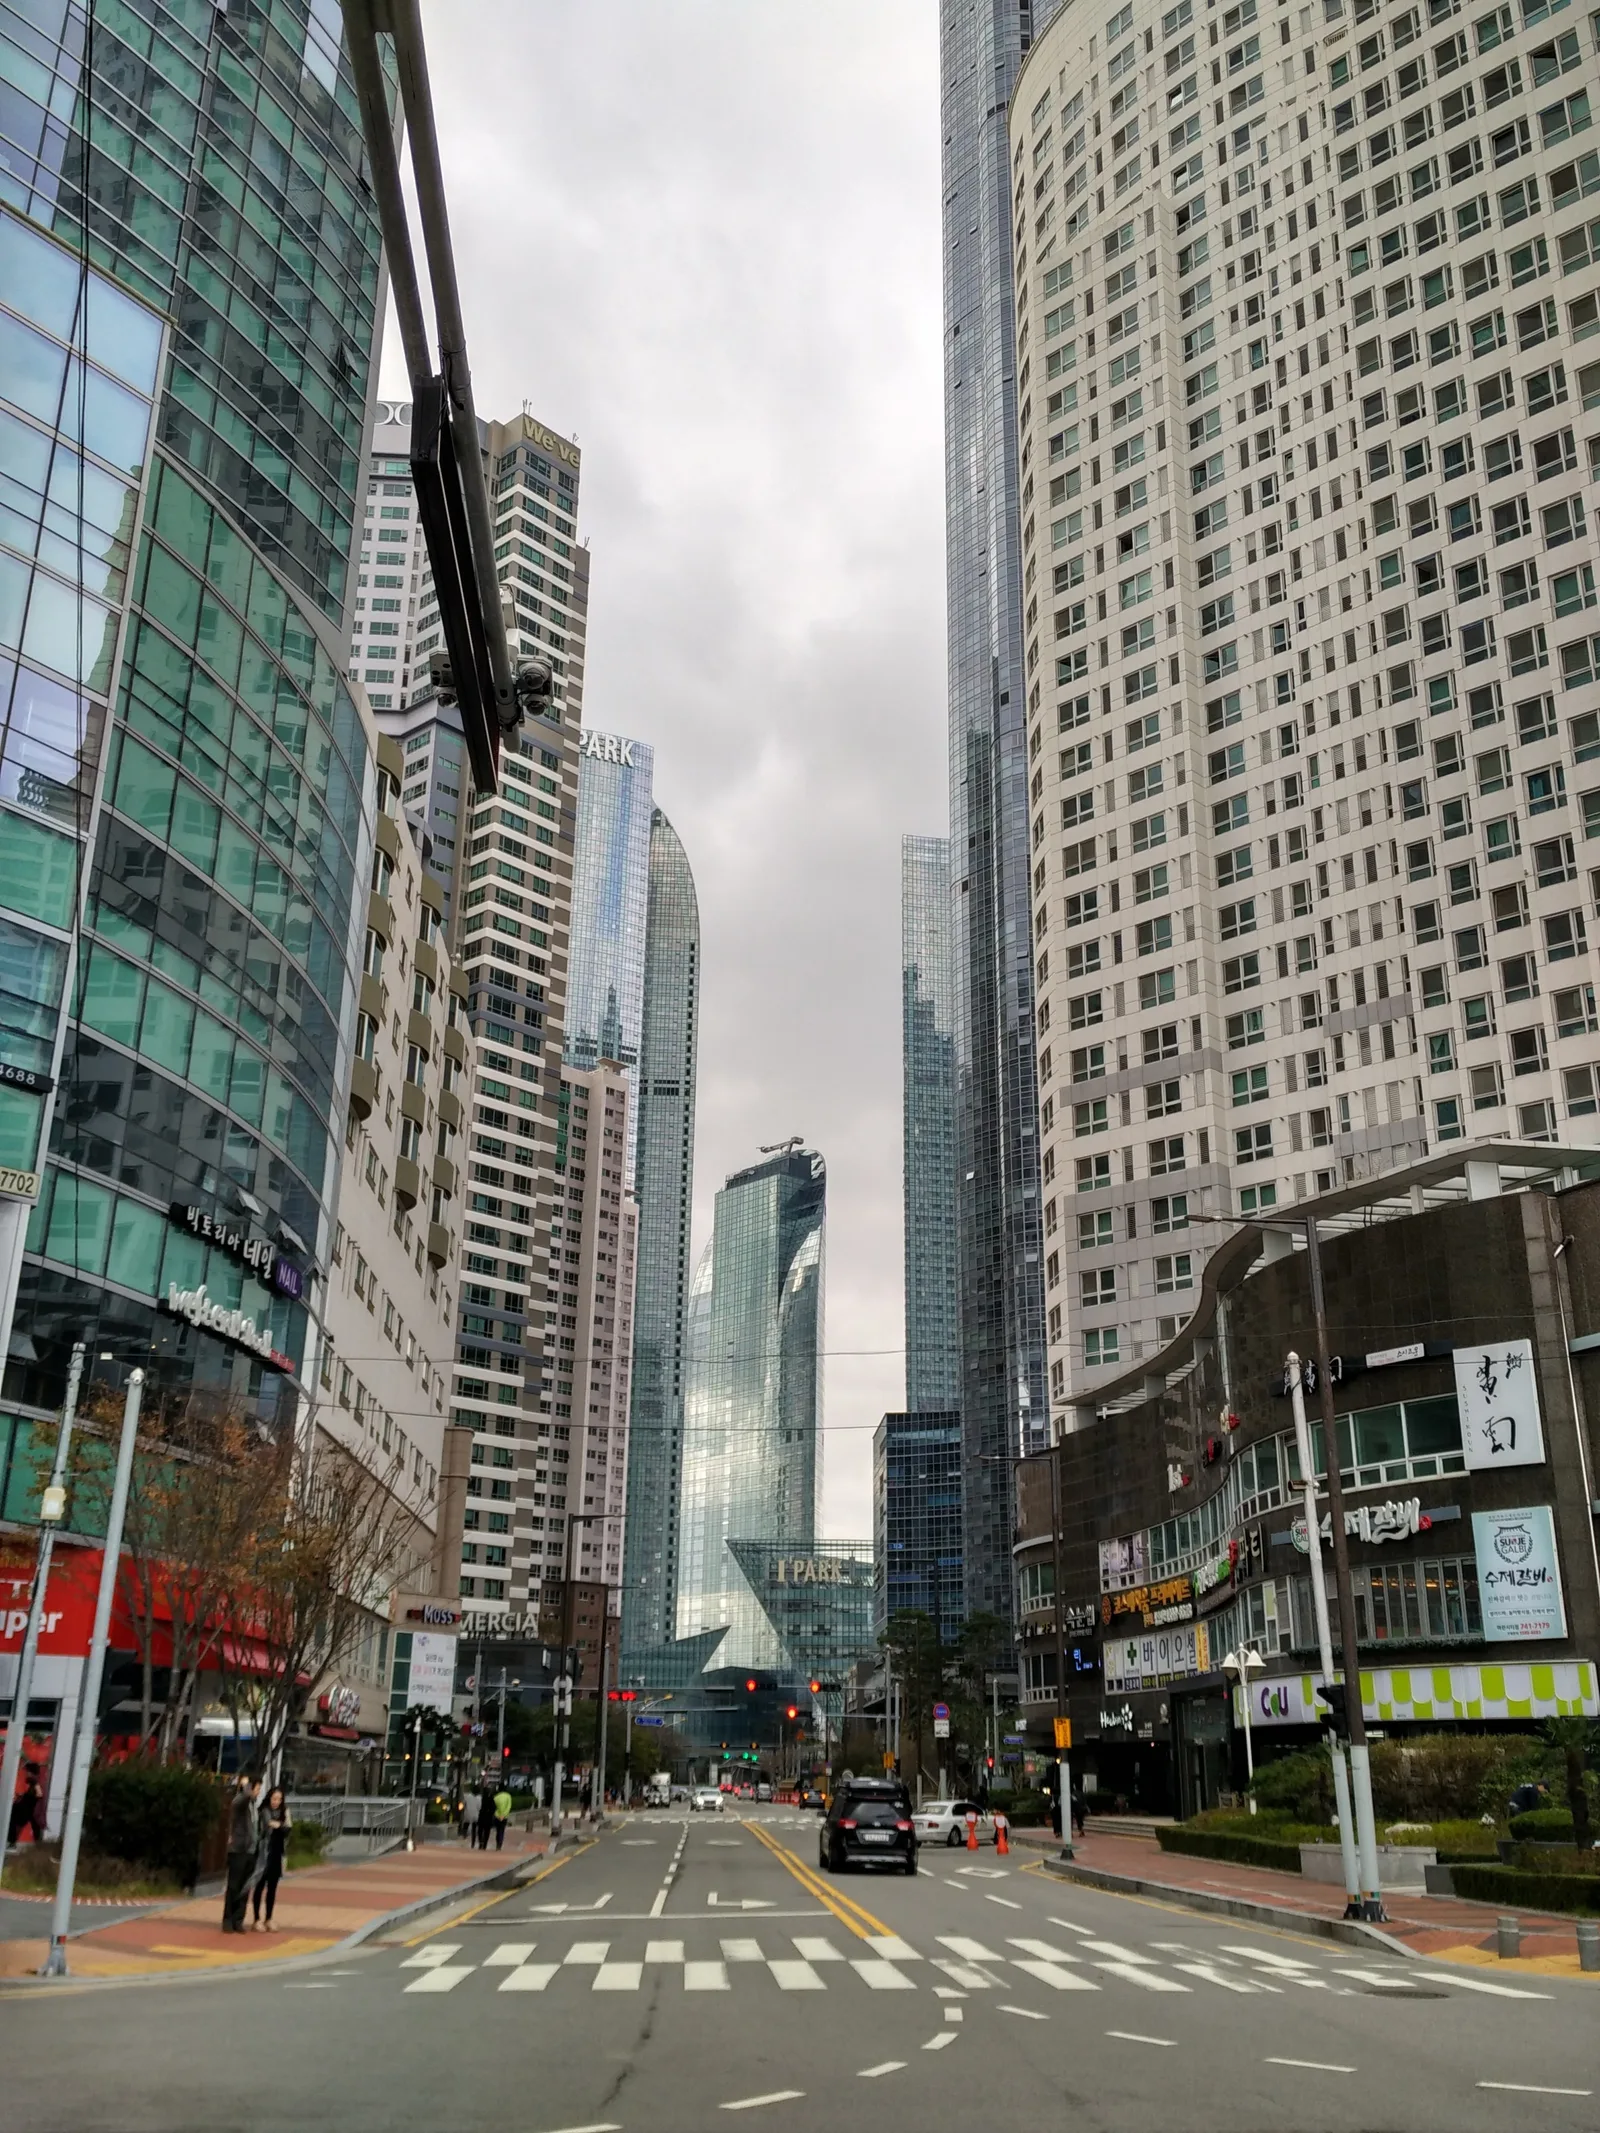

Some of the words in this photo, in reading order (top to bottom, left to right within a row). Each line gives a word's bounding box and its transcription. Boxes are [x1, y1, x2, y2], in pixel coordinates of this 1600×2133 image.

[523, 415, 580, 468] We've
[1, 1171, 35, 1193] 7702
[187, 1206, 240, 1251] 빅토리아
[243, 1240, 273, 1279] 네일
[278, 1263, 298, 1295] NAIL
[1501, 1545, 1527, 1554] GALBI
[1485, 1567, 1547, 1588] 수제갈비
[1261, 1686, 1289, 1717] CU
